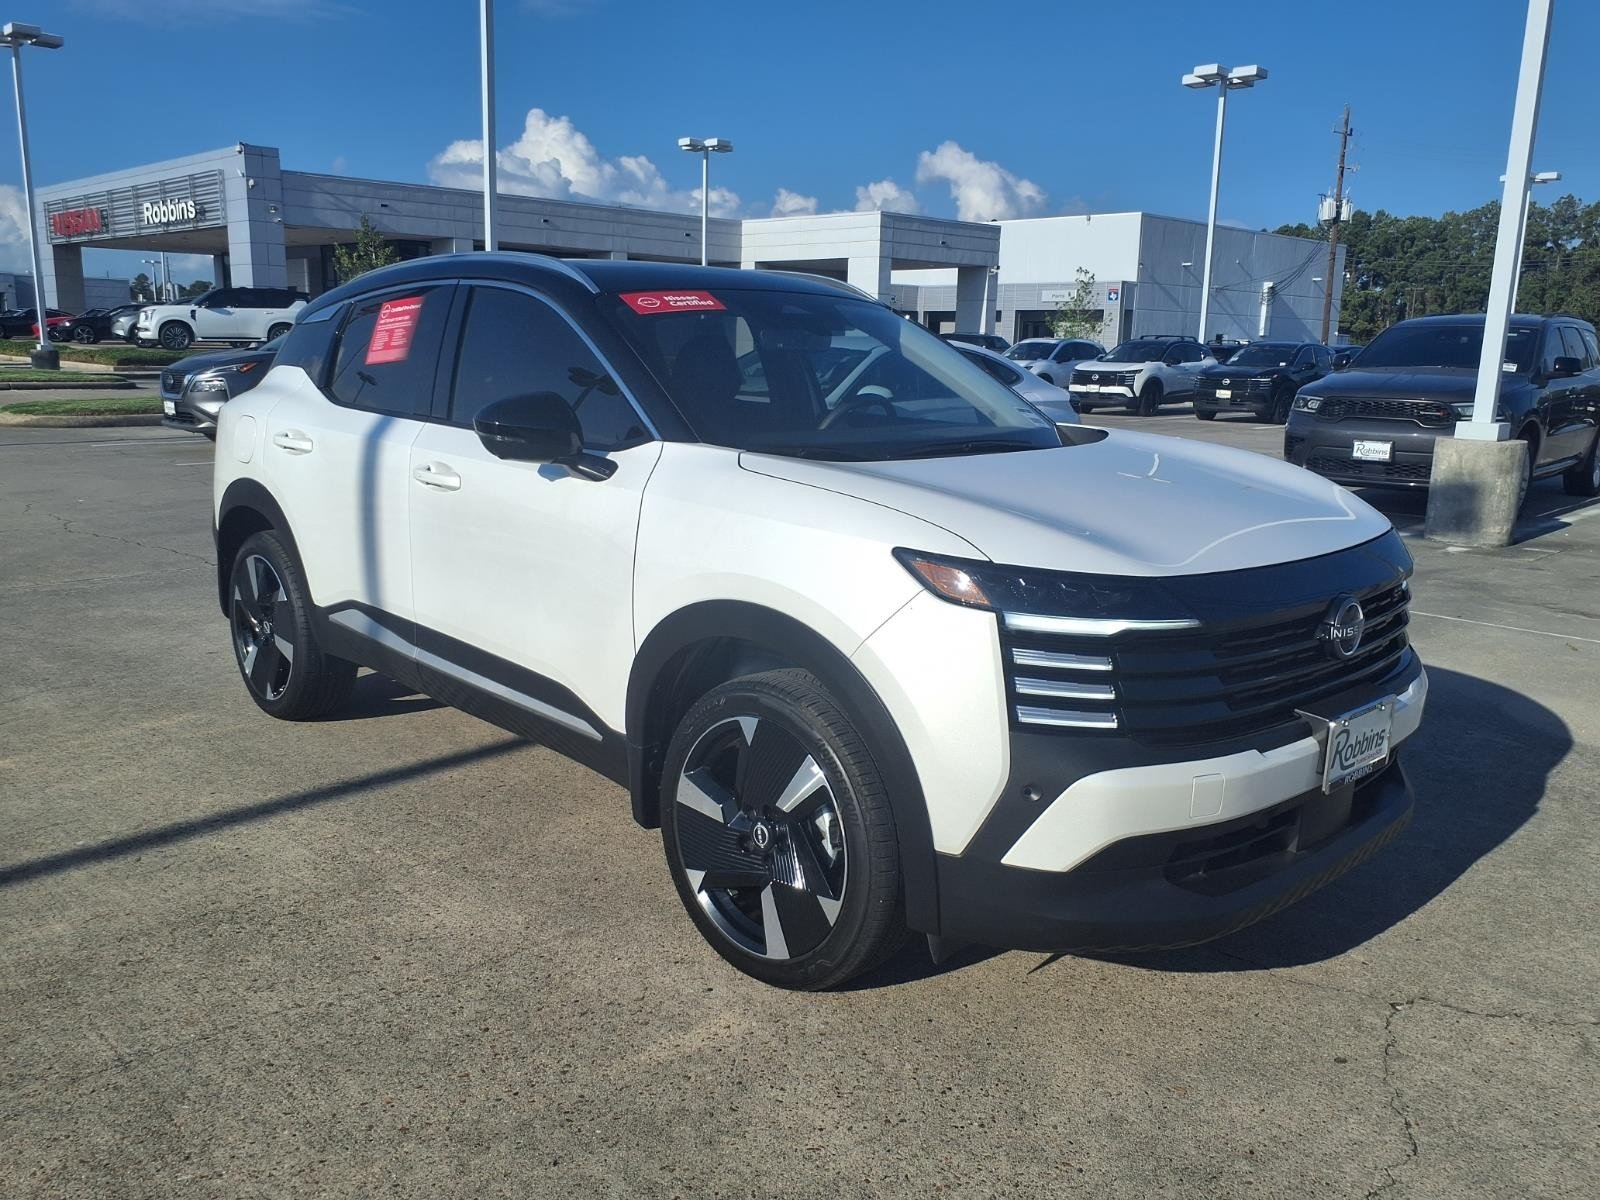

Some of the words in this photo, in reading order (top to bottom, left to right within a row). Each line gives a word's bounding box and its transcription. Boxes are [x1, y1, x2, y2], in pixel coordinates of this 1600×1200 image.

[143, 199, 196, 225] Robbins
[1356, 443, 1388, 456] Robbins
[1331, 728, 1386, 771] Robbins
